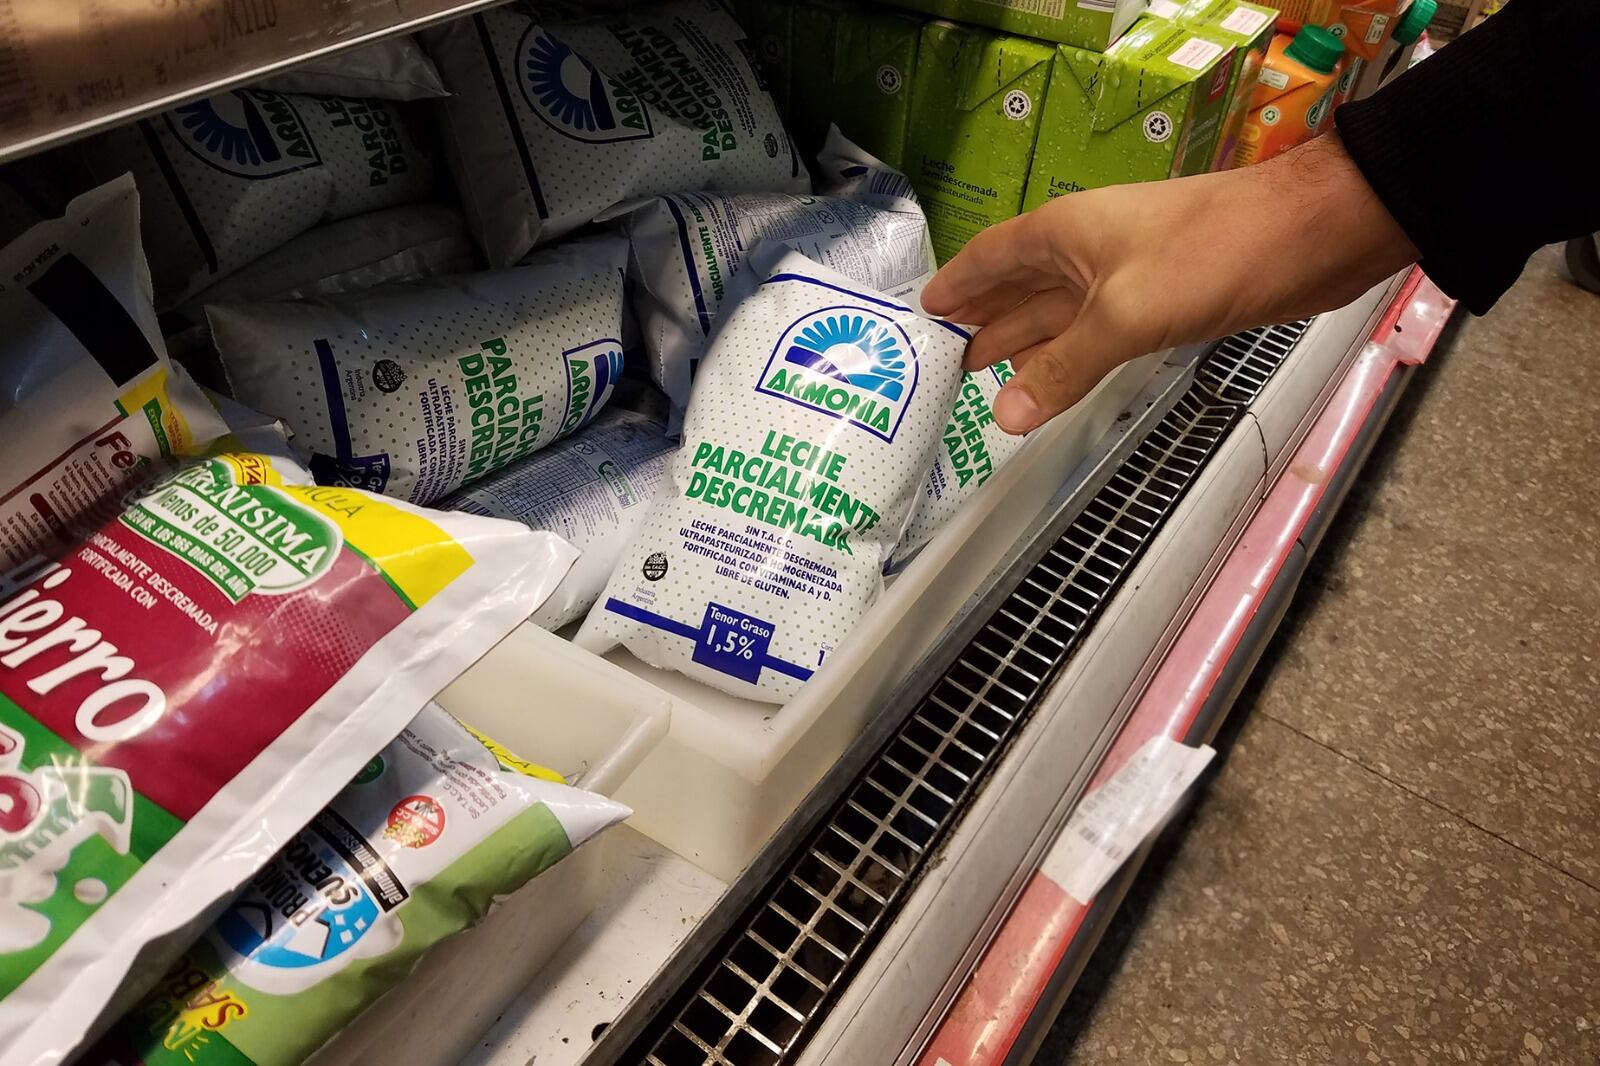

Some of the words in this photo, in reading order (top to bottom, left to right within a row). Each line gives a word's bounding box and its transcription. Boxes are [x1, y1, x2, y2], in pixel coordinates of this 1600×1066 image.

[1049, 176, 1086, 193] Leche
[697, 222, 723, 300] PARCIALMENTE
[440, 385, 450, 411] LECHE
[767, 368, 891, 433] ARMONIA
[96, 431, 135, 469] Fe
[417, 437, 427, 465] LIBRE
[418, 391, 438, 454] FORTIFICADA
[429, 455, 437, 475] CON
[427, 378, 445, 478] ULTRAPASTEURIZADA
[458, 438, 466, 453] SIN
[760, 430, 846, 481] LECHE
[692, 442, 881, 534] PARCIALMENTE
[929, 469, 942, 500] EIZADA
[934, 457, 947, 488] EMADA
[686, 472, 853, 555] DESCREMADA
[744, 525, 760, 537] SIN
[152, 521, 171, 543] LOS
[169, 531, 189, 553] 365
[189, 543, 213, 567] DIAS
[209, 557, 230, 580] DEL
[227, 572, 251, 597] AÑO
[193, 515, 219, 536] de
[214, 526, 277, 576] 50.000
[678, 527, 768, 565] ULTRAPASTEURIZADA
[769, 557, 843, 593] HOMOGENEIZADA
[682, 541, 737, 567] FORTIFICADA
[738, 560, 758, 574] CON
[757, 566, 808, 592] VITAMINAS
[807, 585, 815, 595] A
[822, 590, 833, 601] D.
[691, 519, 716, 534] LECHE
[717, 527, 783, 558] PARCIALMENTE
[783, 551, 838, 578] DESCREMADA
[78, 547, 132, 594] FORTIFICADA
[132, 583, 158, 610] CON
[148, 569, 219, 635] DESCREMADA
[715, 564, 740, 581] LIBRE
[753, 578, 791, 599] GLUTEN.
[705, 627, 753, 660] 1,5%
[708, 606, 738, 626] Tenor
[739, 617, 770, 638] Graso
[283, 836, 360, 905] SUEÑO
